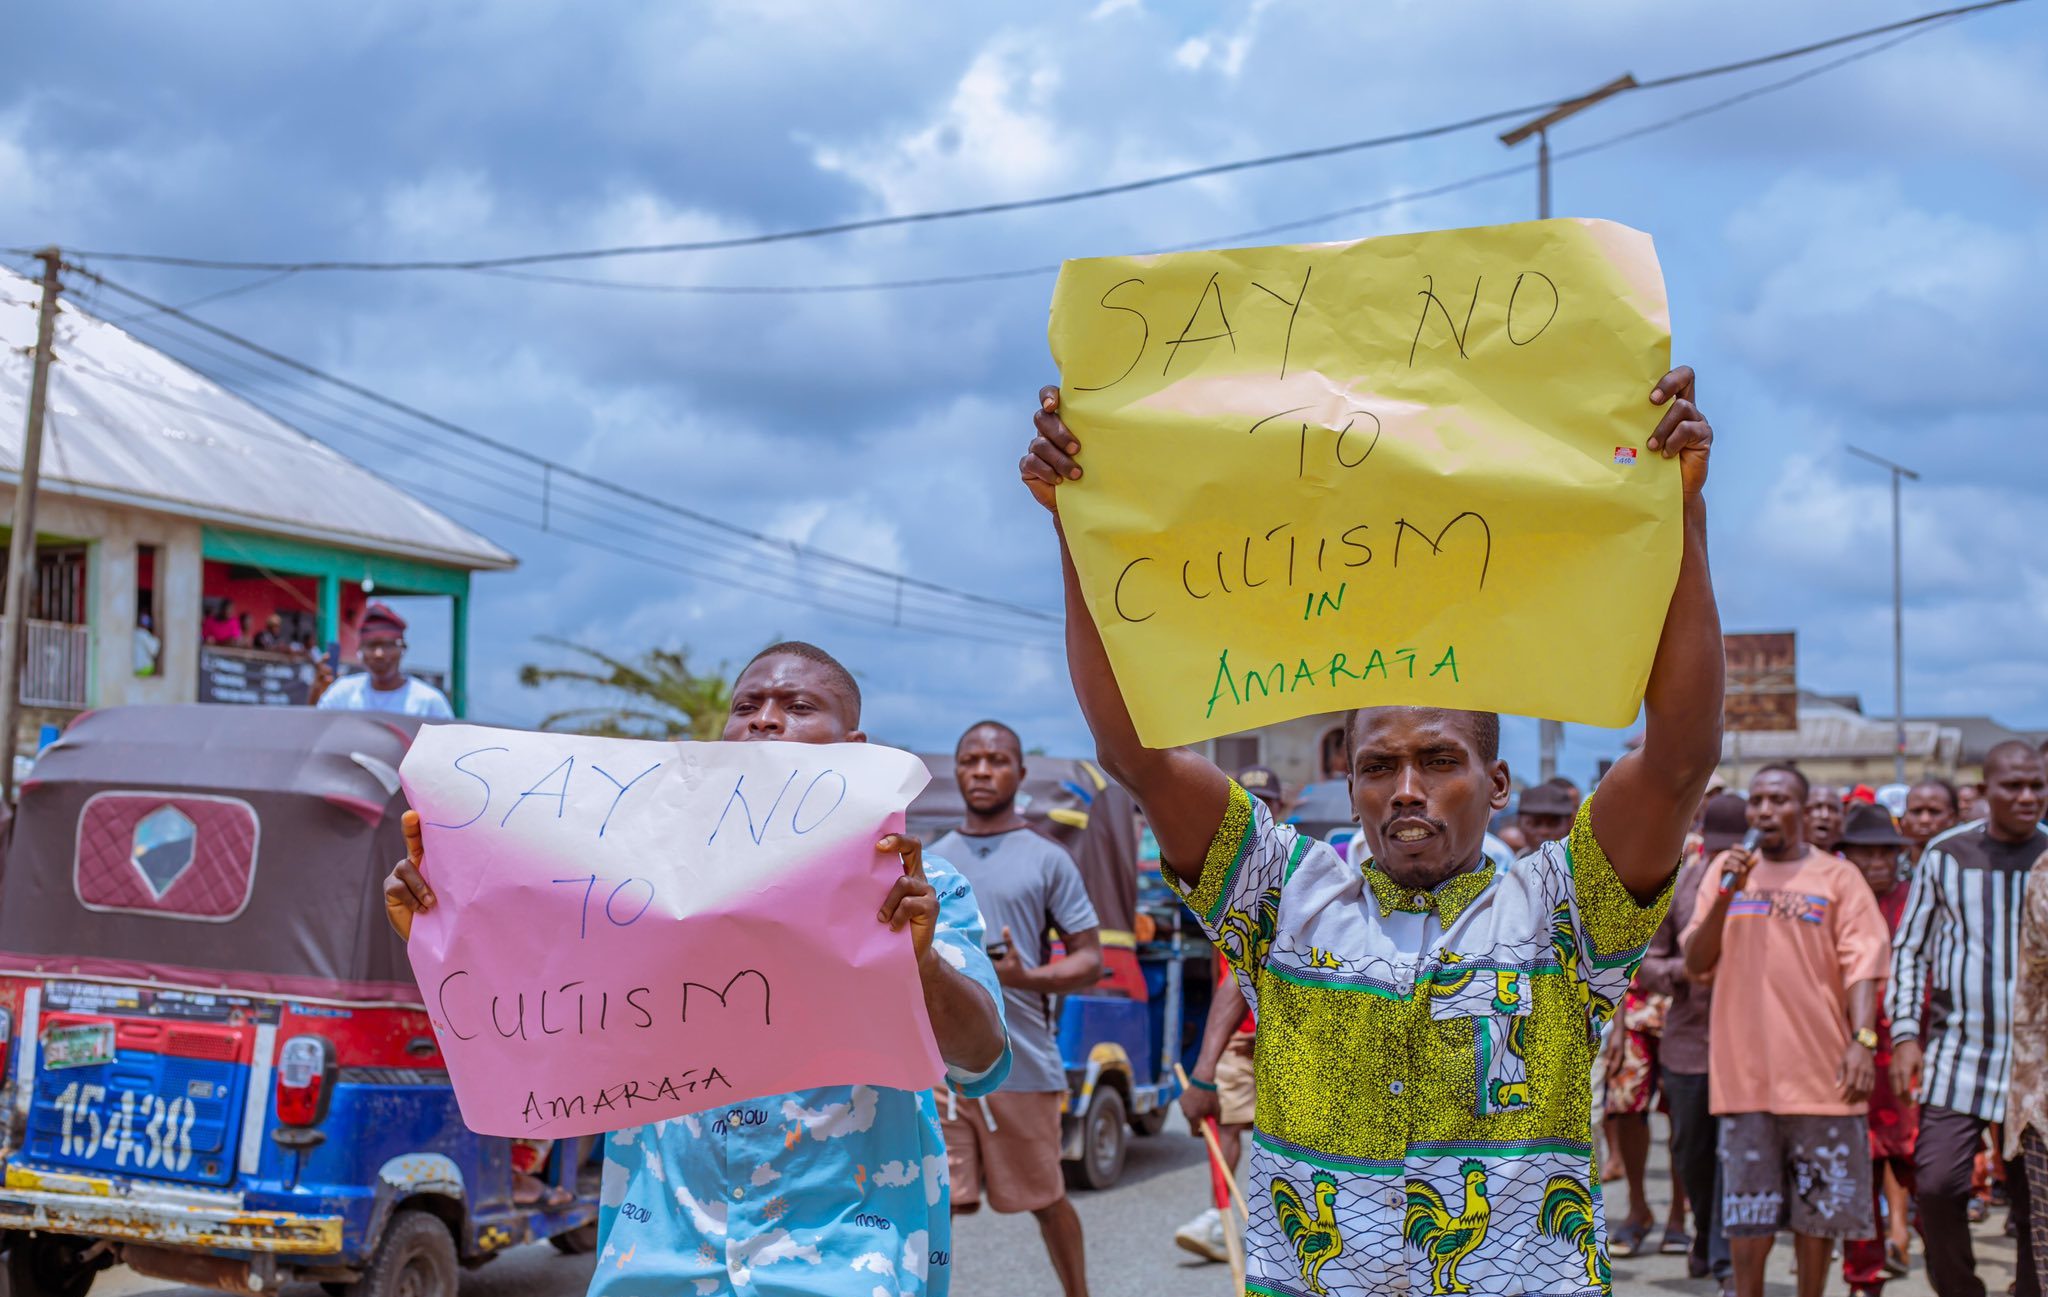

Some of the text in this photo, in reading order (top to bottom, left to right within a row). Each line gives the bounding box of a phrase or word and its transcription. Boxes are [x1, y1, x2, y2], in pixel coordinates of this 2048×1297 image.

[1072, 265, 1559, 391] SAY NO
[1248, 405, 1381, 478] TO
[1114, 511, 1491, 623] CULTISM
[1303, 582, 1347, 621] IN
[1205, 645, 1460, 719] AMARATA
[425, 747, 847, 846] SAY NO
[552, 874, 655, 939] TO
[437, 969, 771, 1041] CULTISM
[521, 1067, 733, 1125] AMARATA
